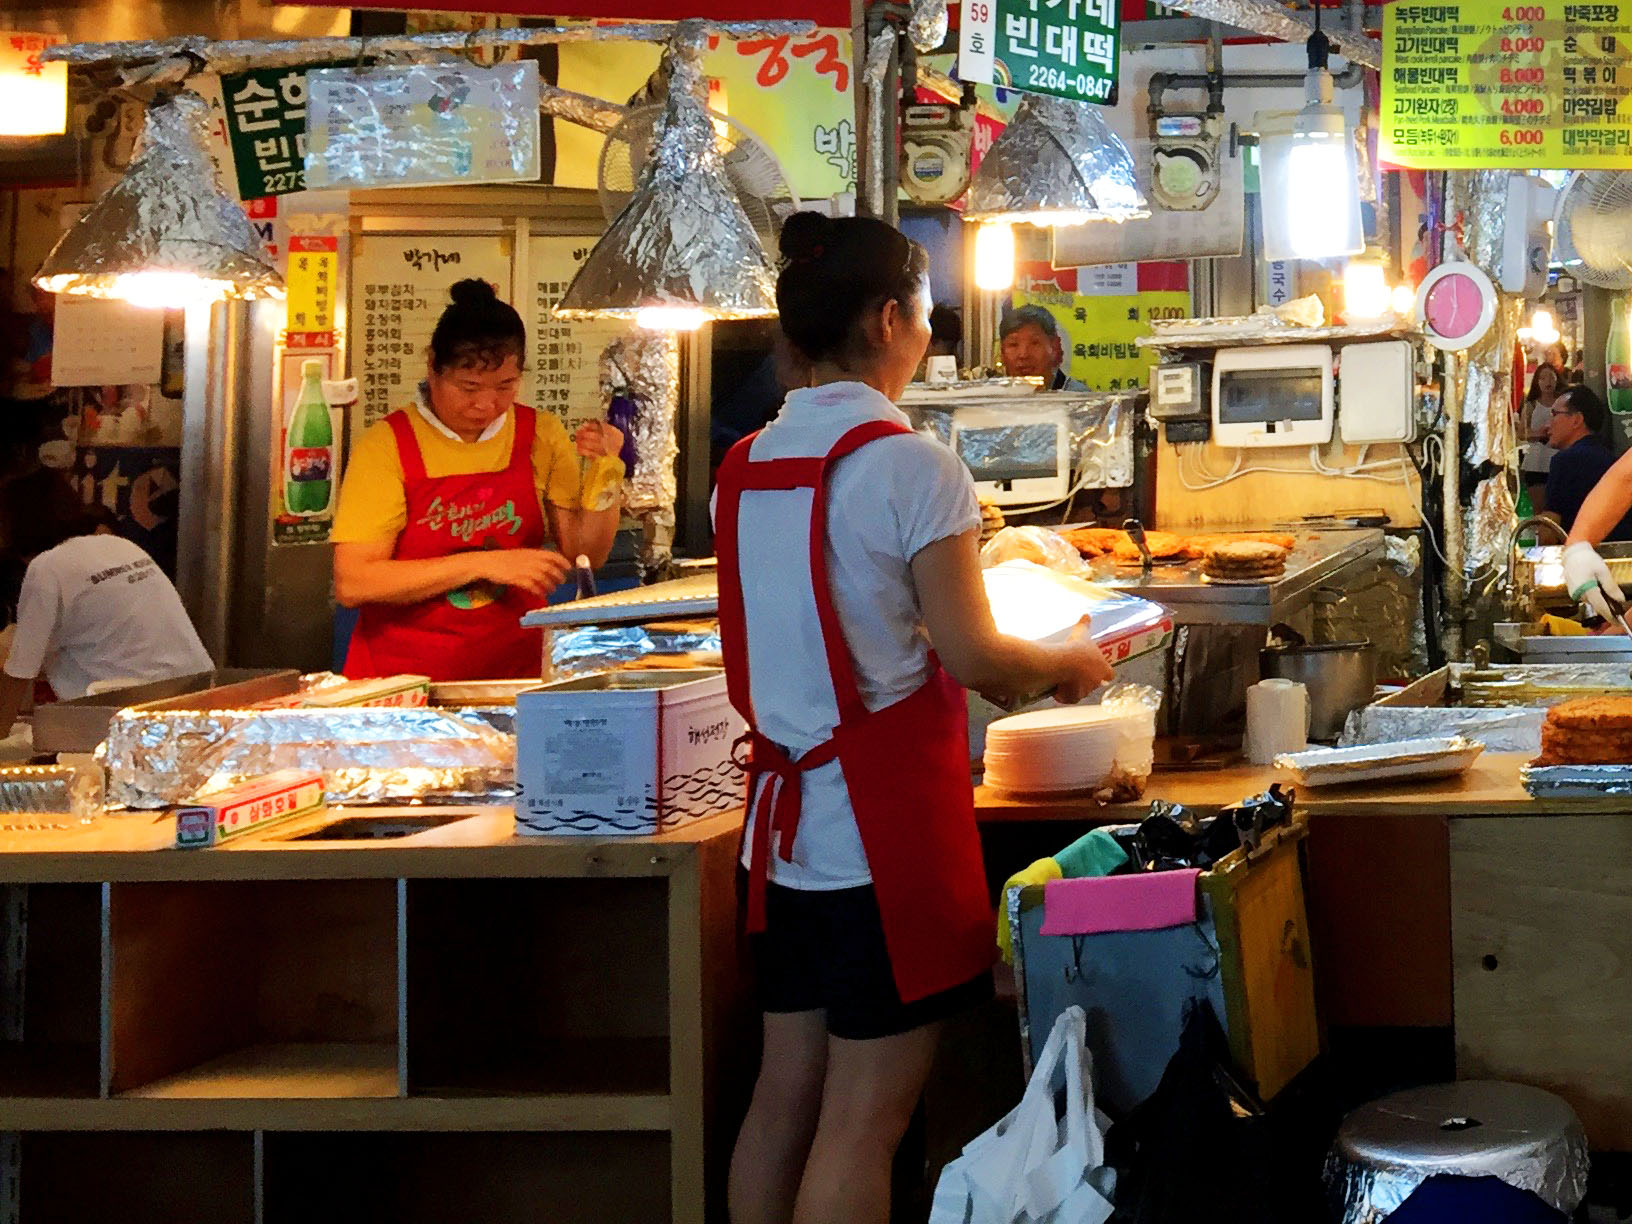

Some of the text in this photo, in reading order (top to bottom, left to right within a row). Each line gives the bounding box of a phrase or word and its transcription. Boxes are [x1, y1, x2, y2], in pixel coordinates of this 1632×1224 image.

[970, 2, 989, 23] 59
[1395, 6, 1545, 23] 녹두빈대떡 4,000
[1563, 5, 1620, 23] 반죽포장
[969, 32, 985, 54] 호
[1005, 13, 1115, 75] 빈대떡
[1394, 37, 1459, 54] 고기빈대떡
[1028, 63, 1114, 99] 2264-0847
[1393, 68, 1458, 85] 해물빈대떡
[1500, 98, 1545, 115] 4,000
[1563, 98, 1619, 116] 마약김밥
[1499, 129, 1544, 145] 6,000
[1562, 129, 1631, 146] 대박막걸리
[403, 248, 461, 272] 박가네
[1073, 342, 1141, 359] 육회비빔밥
